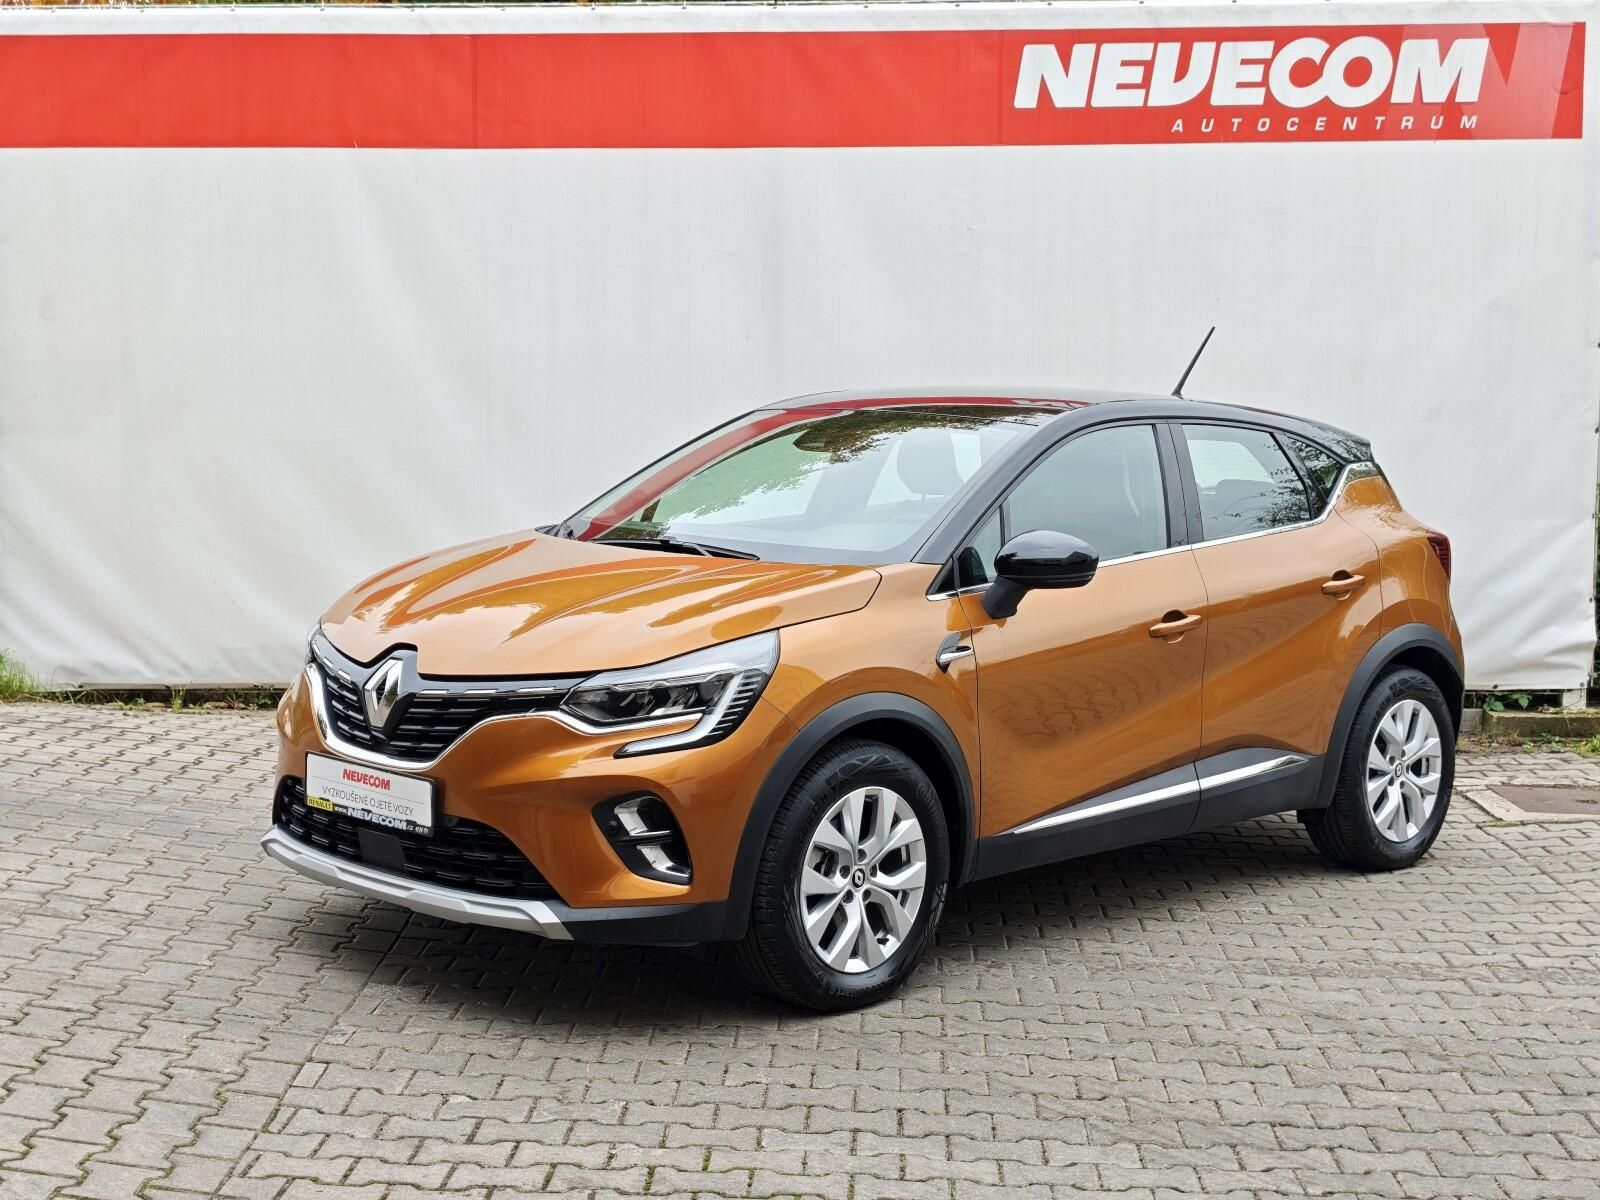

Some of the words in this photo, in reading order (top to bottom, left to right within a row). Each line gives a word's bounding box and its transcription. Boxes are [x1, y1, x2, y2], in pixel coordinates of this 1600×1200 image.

[1013, 35, 1490, 109] NEVECOM
[1170, 114, 1480, 133] AUTOCENTRUM
[342, 768, 391, 791] NEVECOM
[308, 797, 332, 811] RENAULT
[322, 785, 369, 806] VYZKOUŠENÉ
[369, 797, 393, 812] OJETÉ
[392, 803, 415, 817] VOZY
